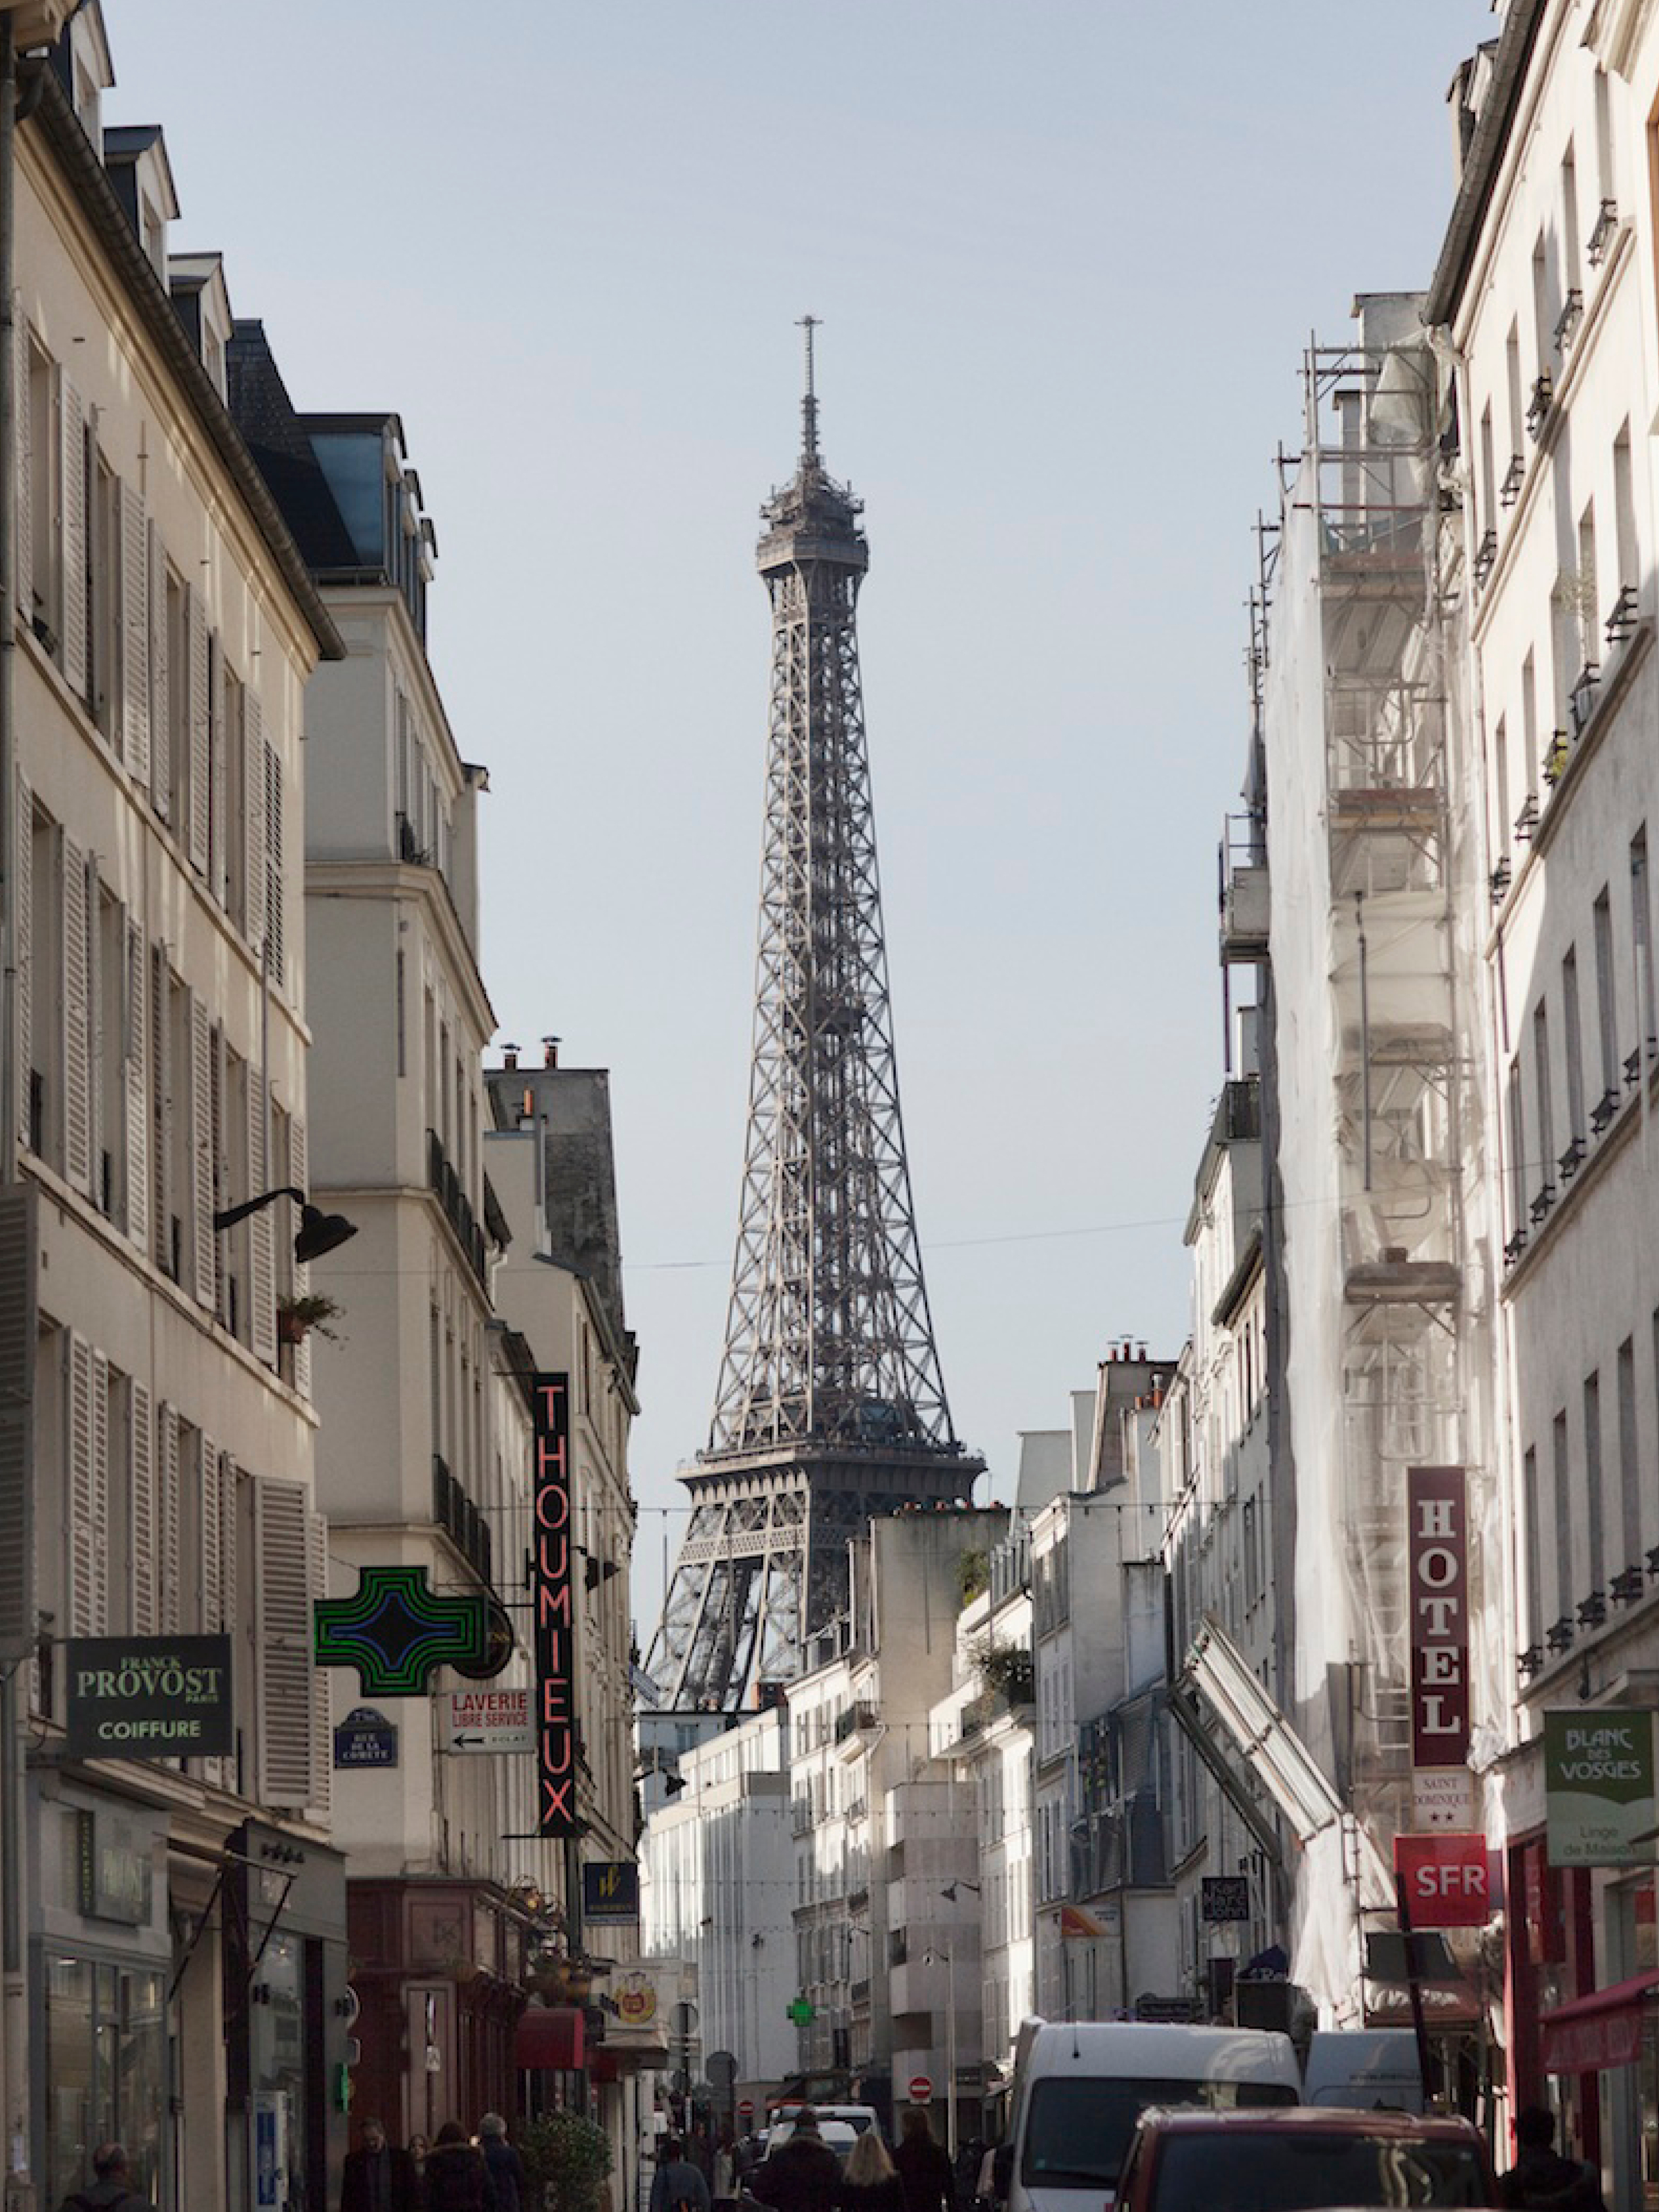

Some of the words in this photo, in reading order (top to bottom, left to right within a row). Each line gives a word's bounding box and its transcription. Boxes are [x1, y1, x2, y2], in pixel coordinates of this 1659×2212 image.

[536, 1386, 572, 1823] THOUMIEUX
[1416, 1499, 1461, 1734] HOTEL
[120, 1656, 182, 1670] FRANCK
[77, 1667, 222, 1697] PROVOST
[451, 1692, 527, 1710] LAVERIE
[451, 1712, 482, 1727] LIBRE
[485, 1711, 528, 1727] SERVICE
[98, 1720, 201, 1740] COIFFURE
[1565, 1728, 1633, 1752] BLANC
[1588, 1748, 1611, 1760] DES
[1559, 1760, 1642, 1779] VOSGES
[1422, 1777, 1457, 1790] SAINT
[1417, 1865, 1486, 1897] SFR
